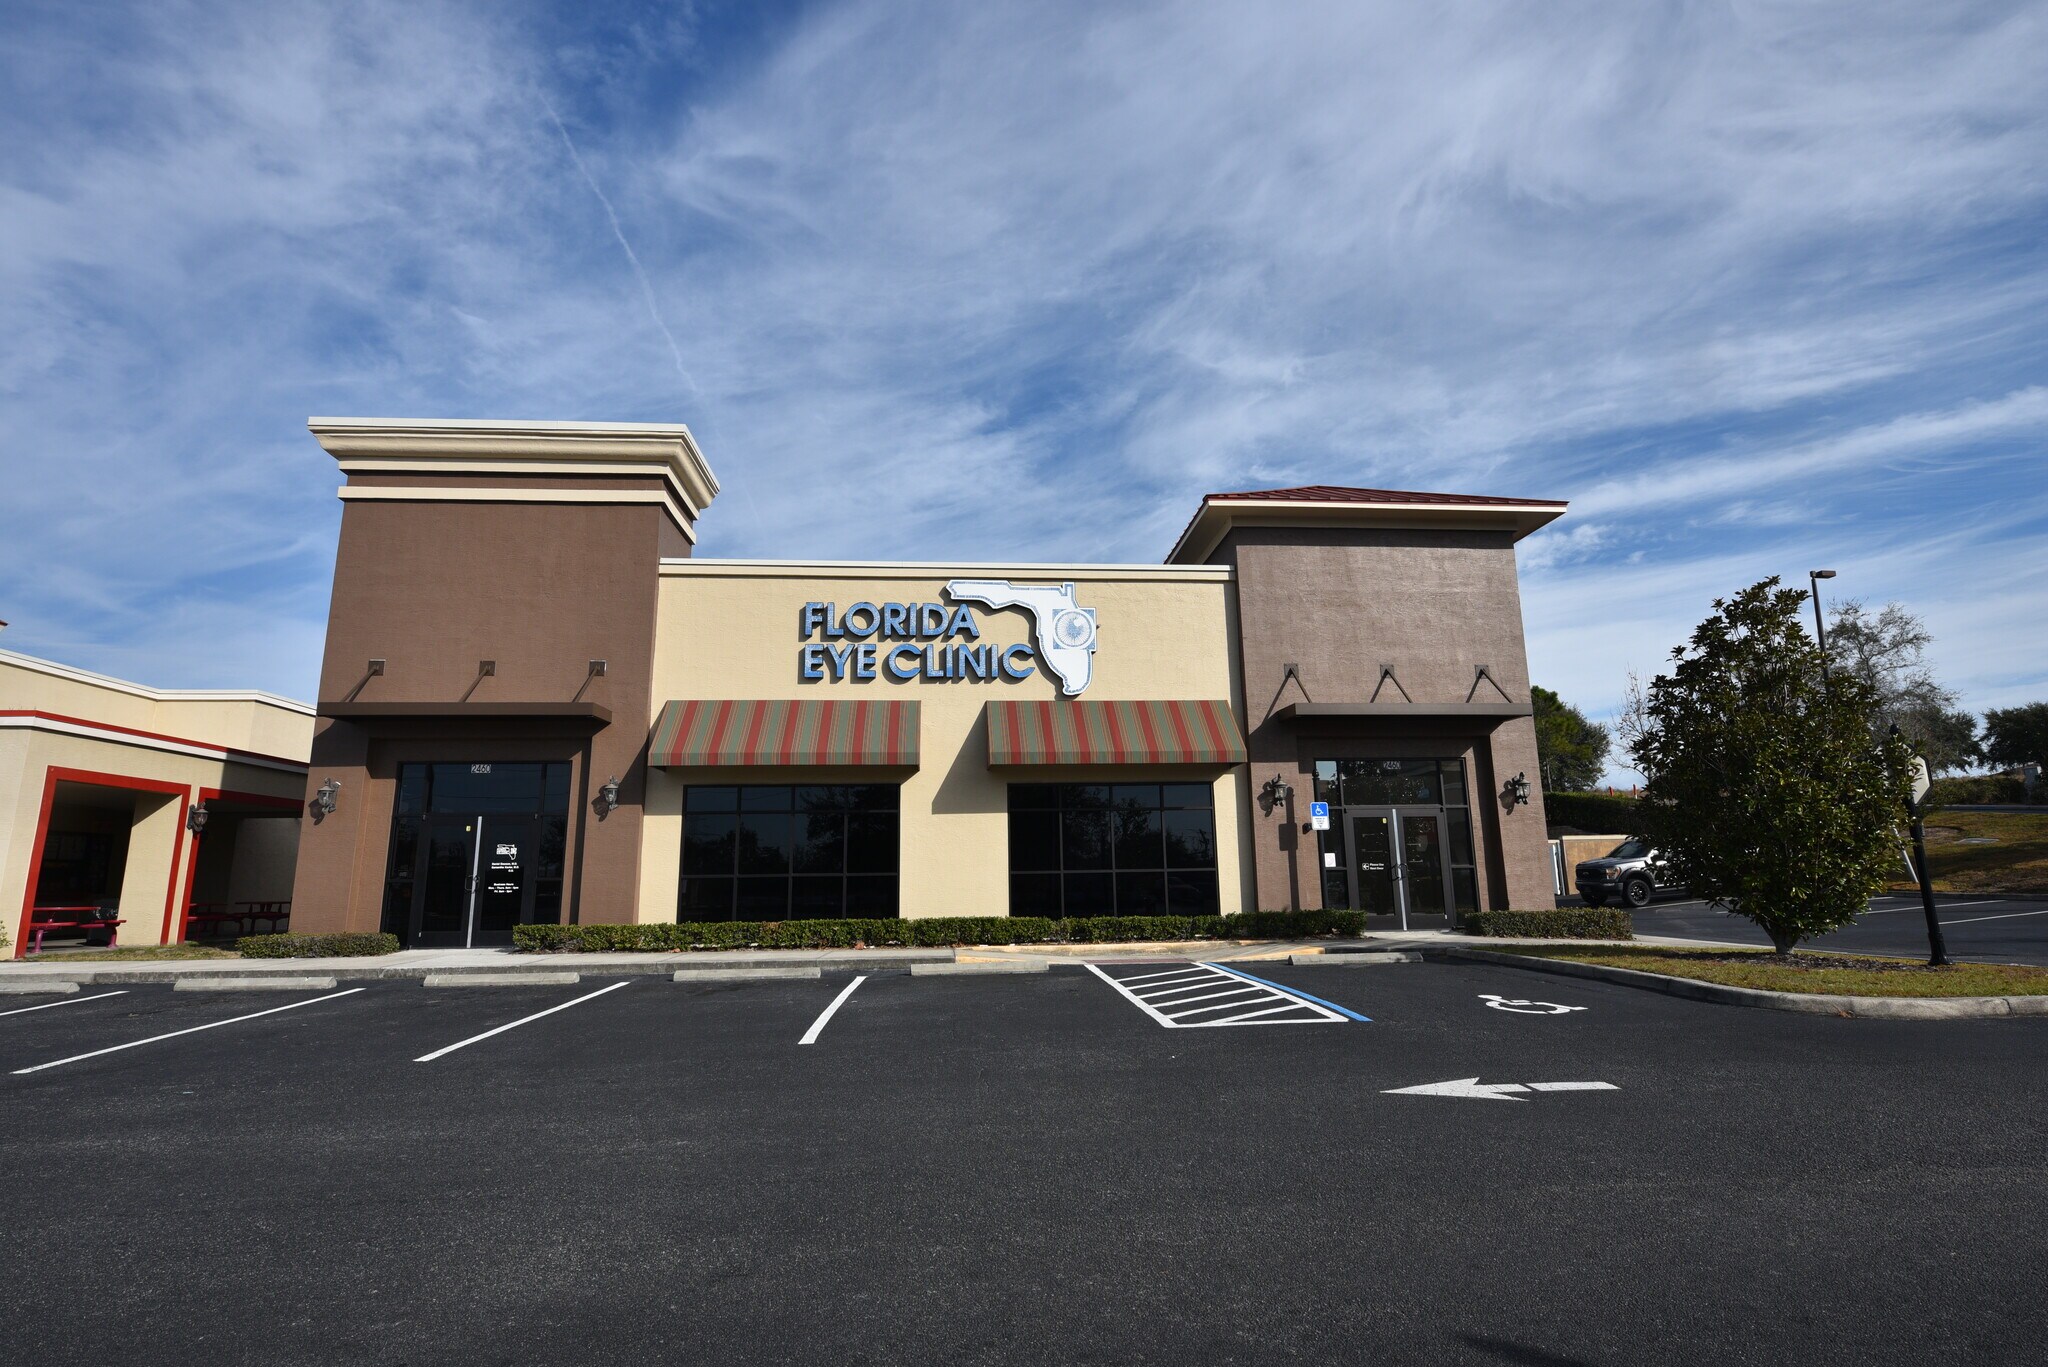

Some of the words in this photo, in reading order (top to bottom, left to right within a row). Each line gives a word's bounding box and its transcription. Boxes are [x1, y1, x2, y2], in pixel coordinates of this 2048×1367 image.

[804, 602, 980, 637] FLORIDA
[803, 643, 877, 678] EYE
[888, 643, 1036, 678] CLINIC
[471, 764, 491, 773] 2460
